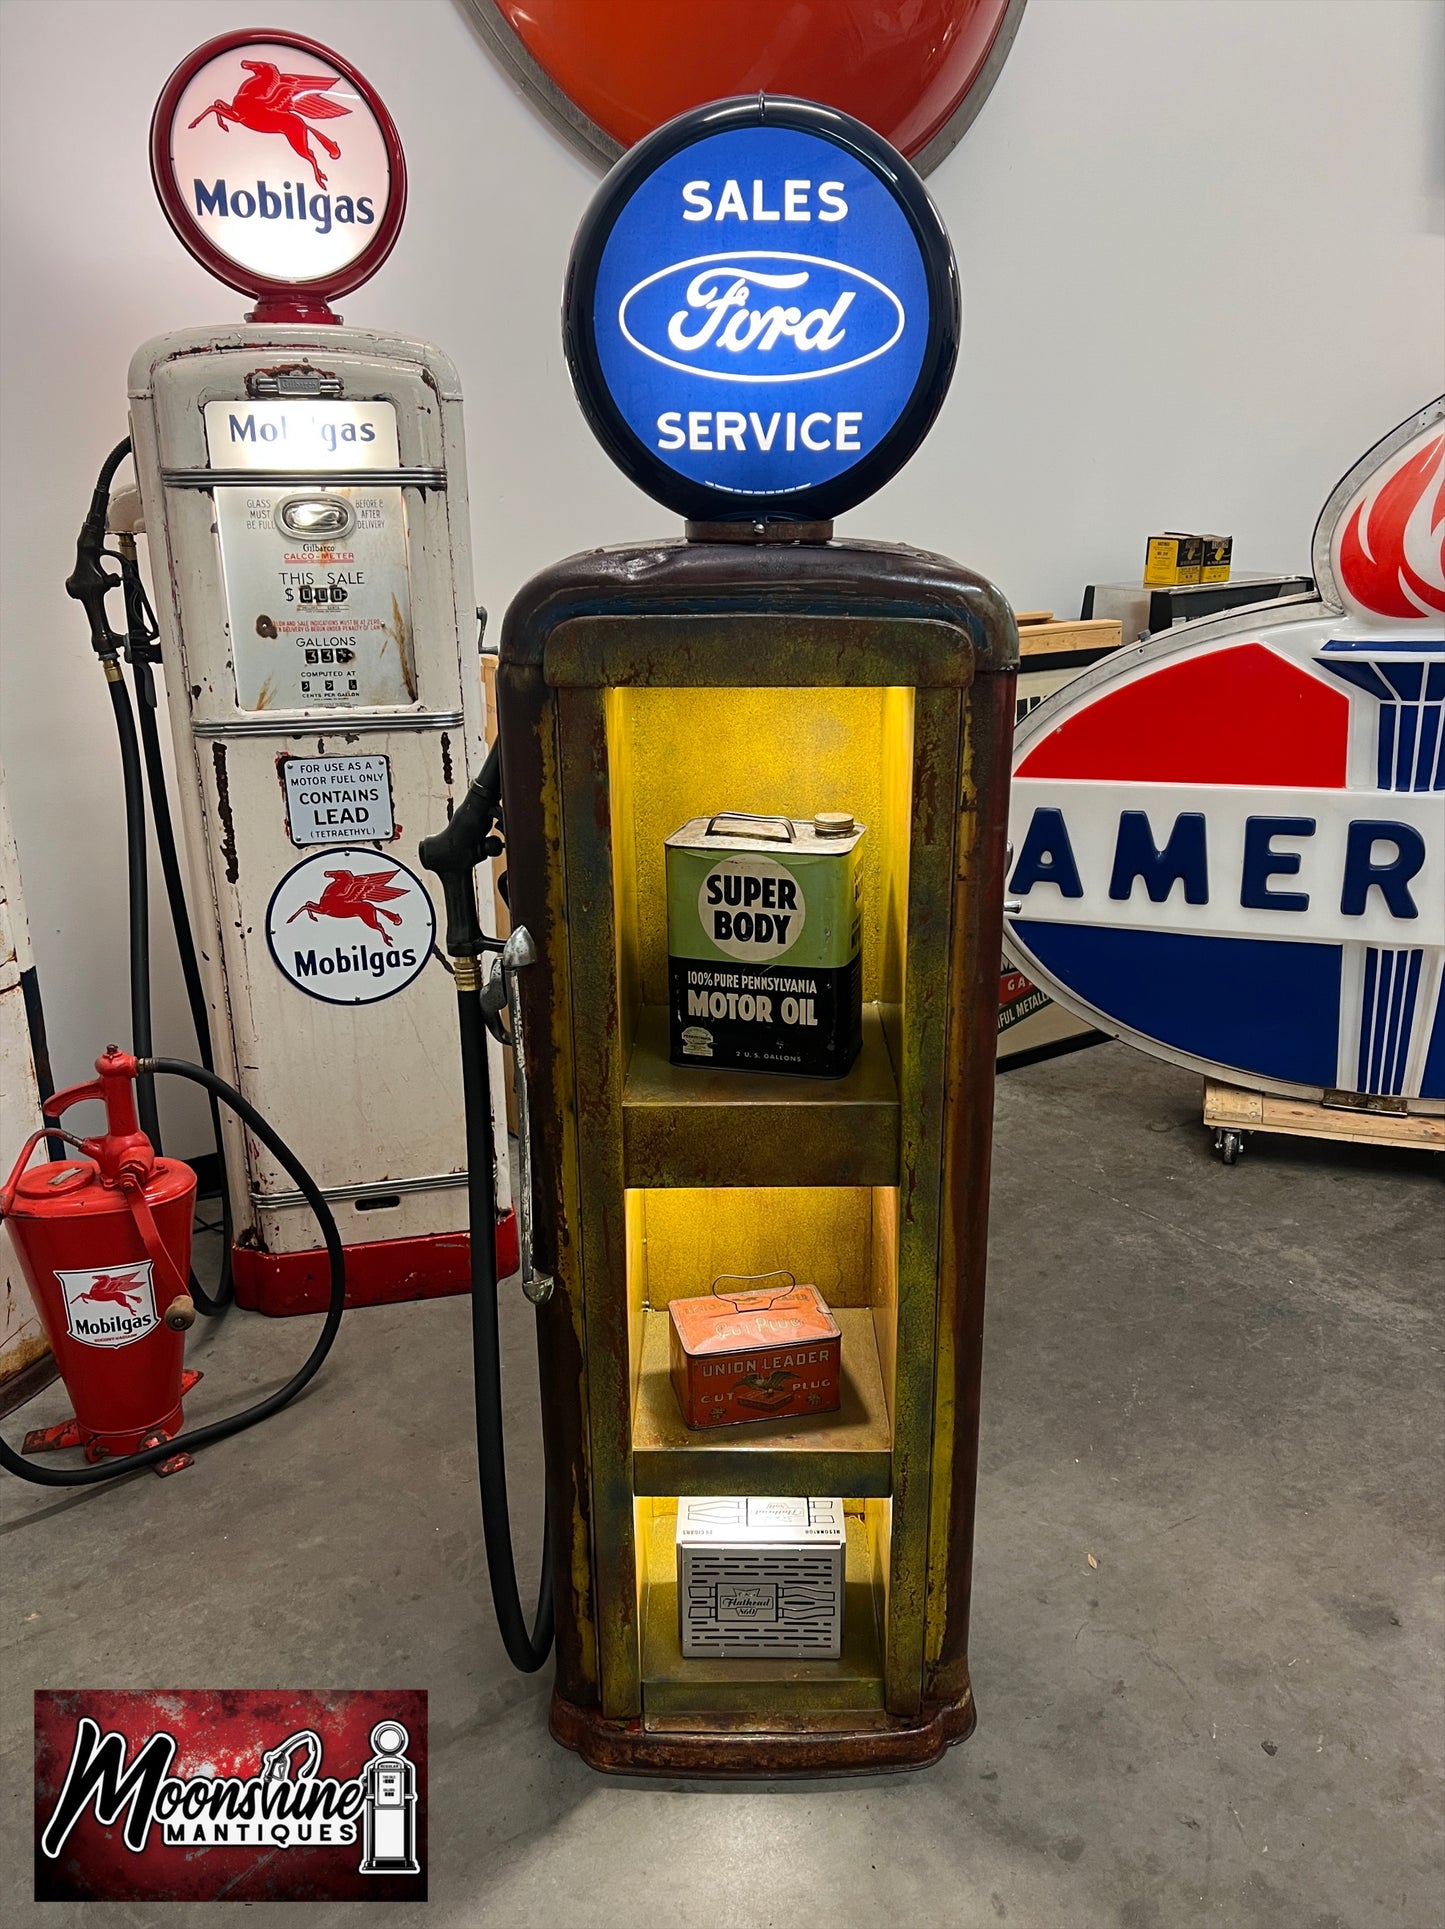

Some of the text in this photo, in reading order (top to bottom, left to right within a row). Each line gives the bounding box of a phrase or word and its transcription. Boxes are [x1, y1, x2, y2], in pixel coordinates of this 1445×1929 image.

[193, 178, 375, 234] Mobilgas
[682, 179, 849, 222] SALES
[667, 266, 857, 352] Ford
[657, 411, 863, 452] SERVICE
[246, 499, 271, 508] GLASS
[250, 511, 271, 519] MUST
[361, 510, 381, 519] AFTER
[246, 520, 256, 529] BE
[357, 520, 385, 529] DELIVERY
[302, 543, 335, 552] Gilbarco
[279, 572, 365, 585] THIS SALE
[285, 587, 294, 602] $
[296, 637, 356, 647] GALLONS
[300, 761, 372, 773] FOR USE AS A
[291, 773, 384, 786] MOTOR FUEL ONLY
[299, 788, 379, 805] CONTAINS
[314, 807, 370, 826] LEAD
[310, 827, 375, 839] (TETRAETHYL)
[1008, 806, 1425, 919] AMER
[706, 874, 797, 911] SUPER
[713, 910, 792, 945] BODY
[294, 944, 417, 978] Mobilgas
[687, 970, 818, 994] 100% PURE PENNSYLVANIA
[687, 989, 818, 1026] MOTOR OIL
[763, 1053, 802, 1062] GALLONS
[75, 1314, 152, 1335] Mobilgas
[702, 1350, 830, 1378] UNION LEADER
[700, 1379, 831, 1404] CUT PLUG
[722, 1597, 771, 1607] Flathead
